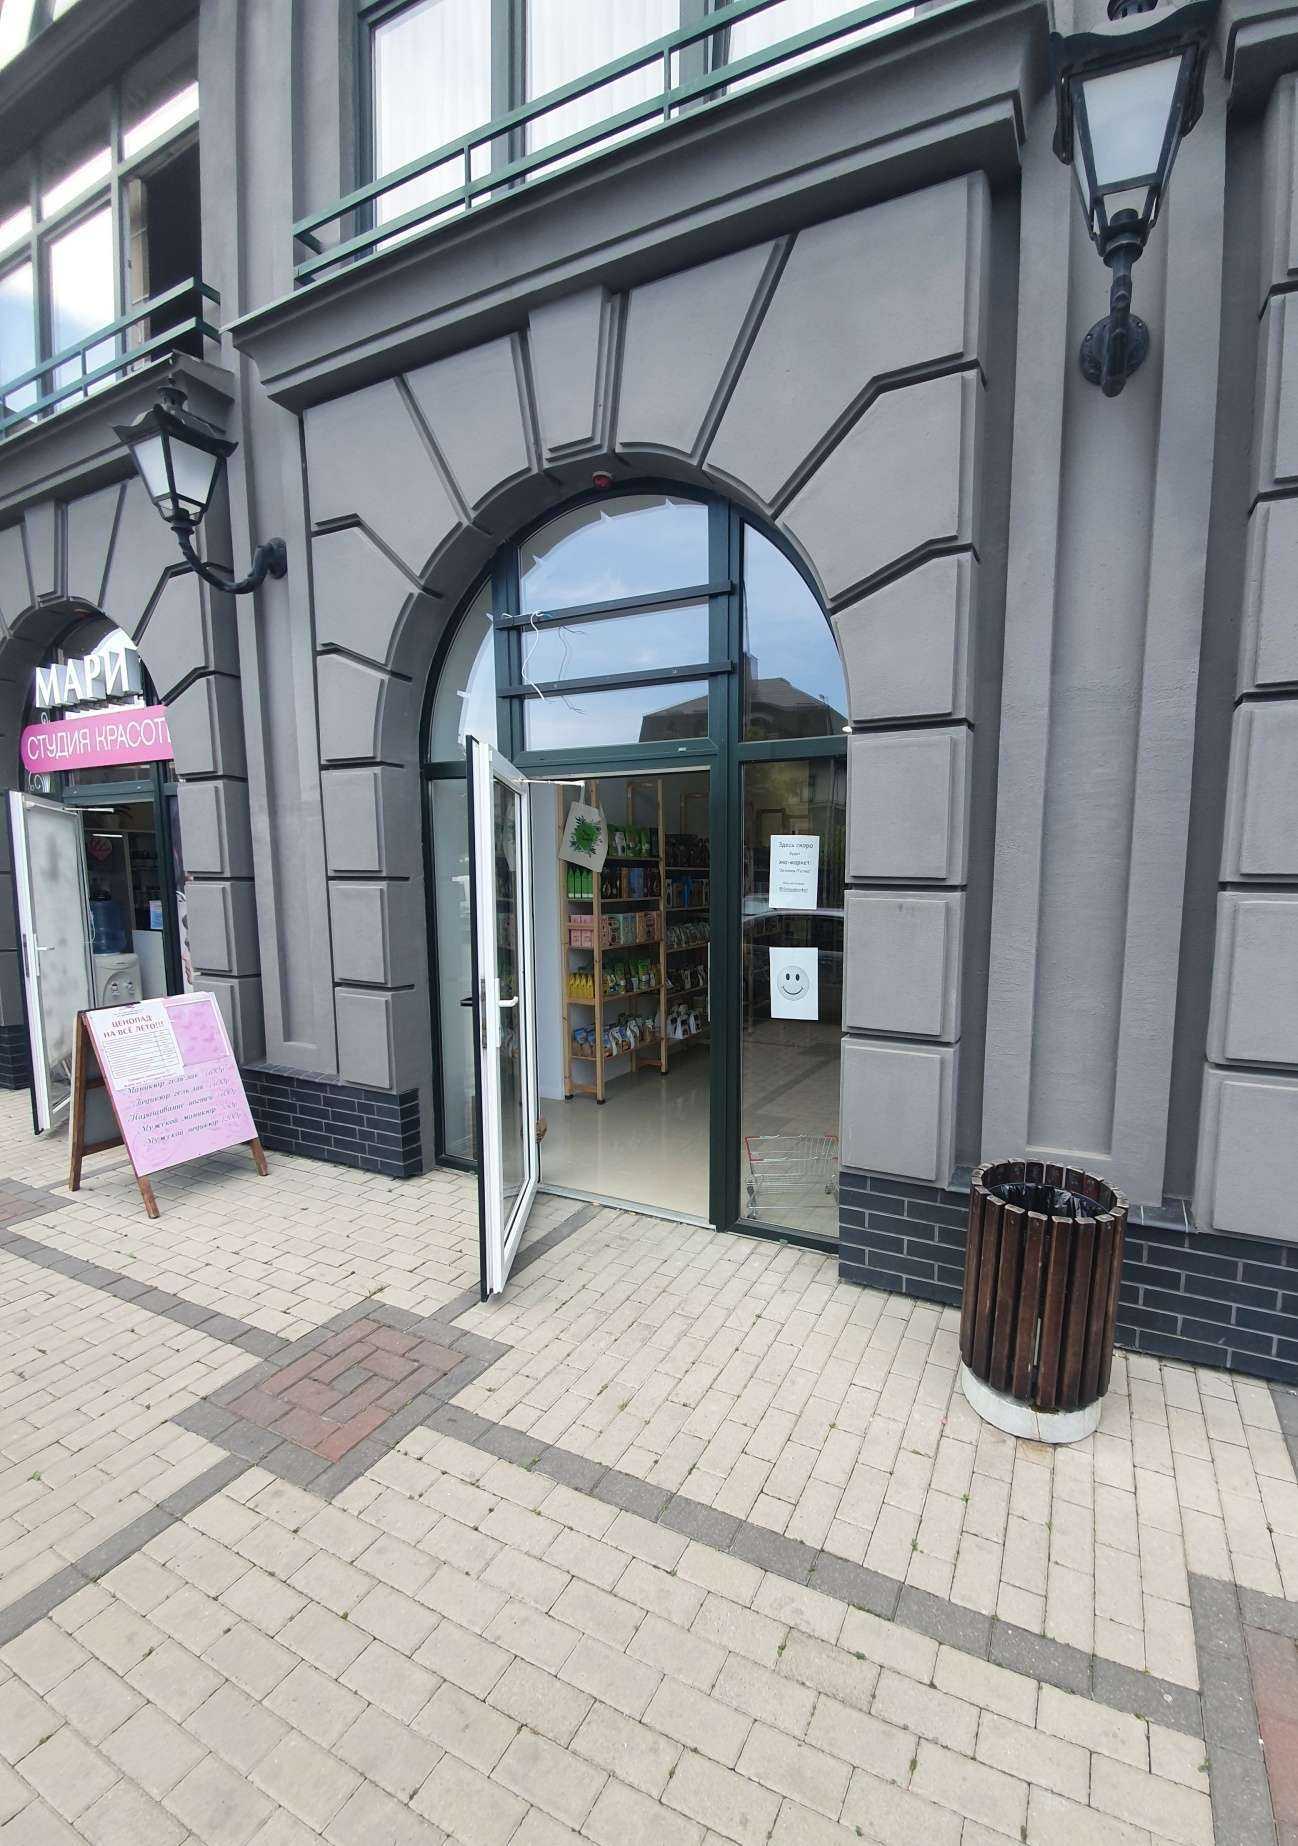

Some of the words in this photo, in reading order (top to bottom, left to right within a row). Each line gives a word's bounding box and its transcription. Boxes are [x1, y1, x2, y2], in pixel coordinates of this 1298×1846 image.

[35, 651, 131, 708] МАРИ
[27, 728, 91, 760] СТУДИЯ
[112, 1015, 153, 1028] ЦЕНОПАД
[103, 1030, 116, 1039] НА
